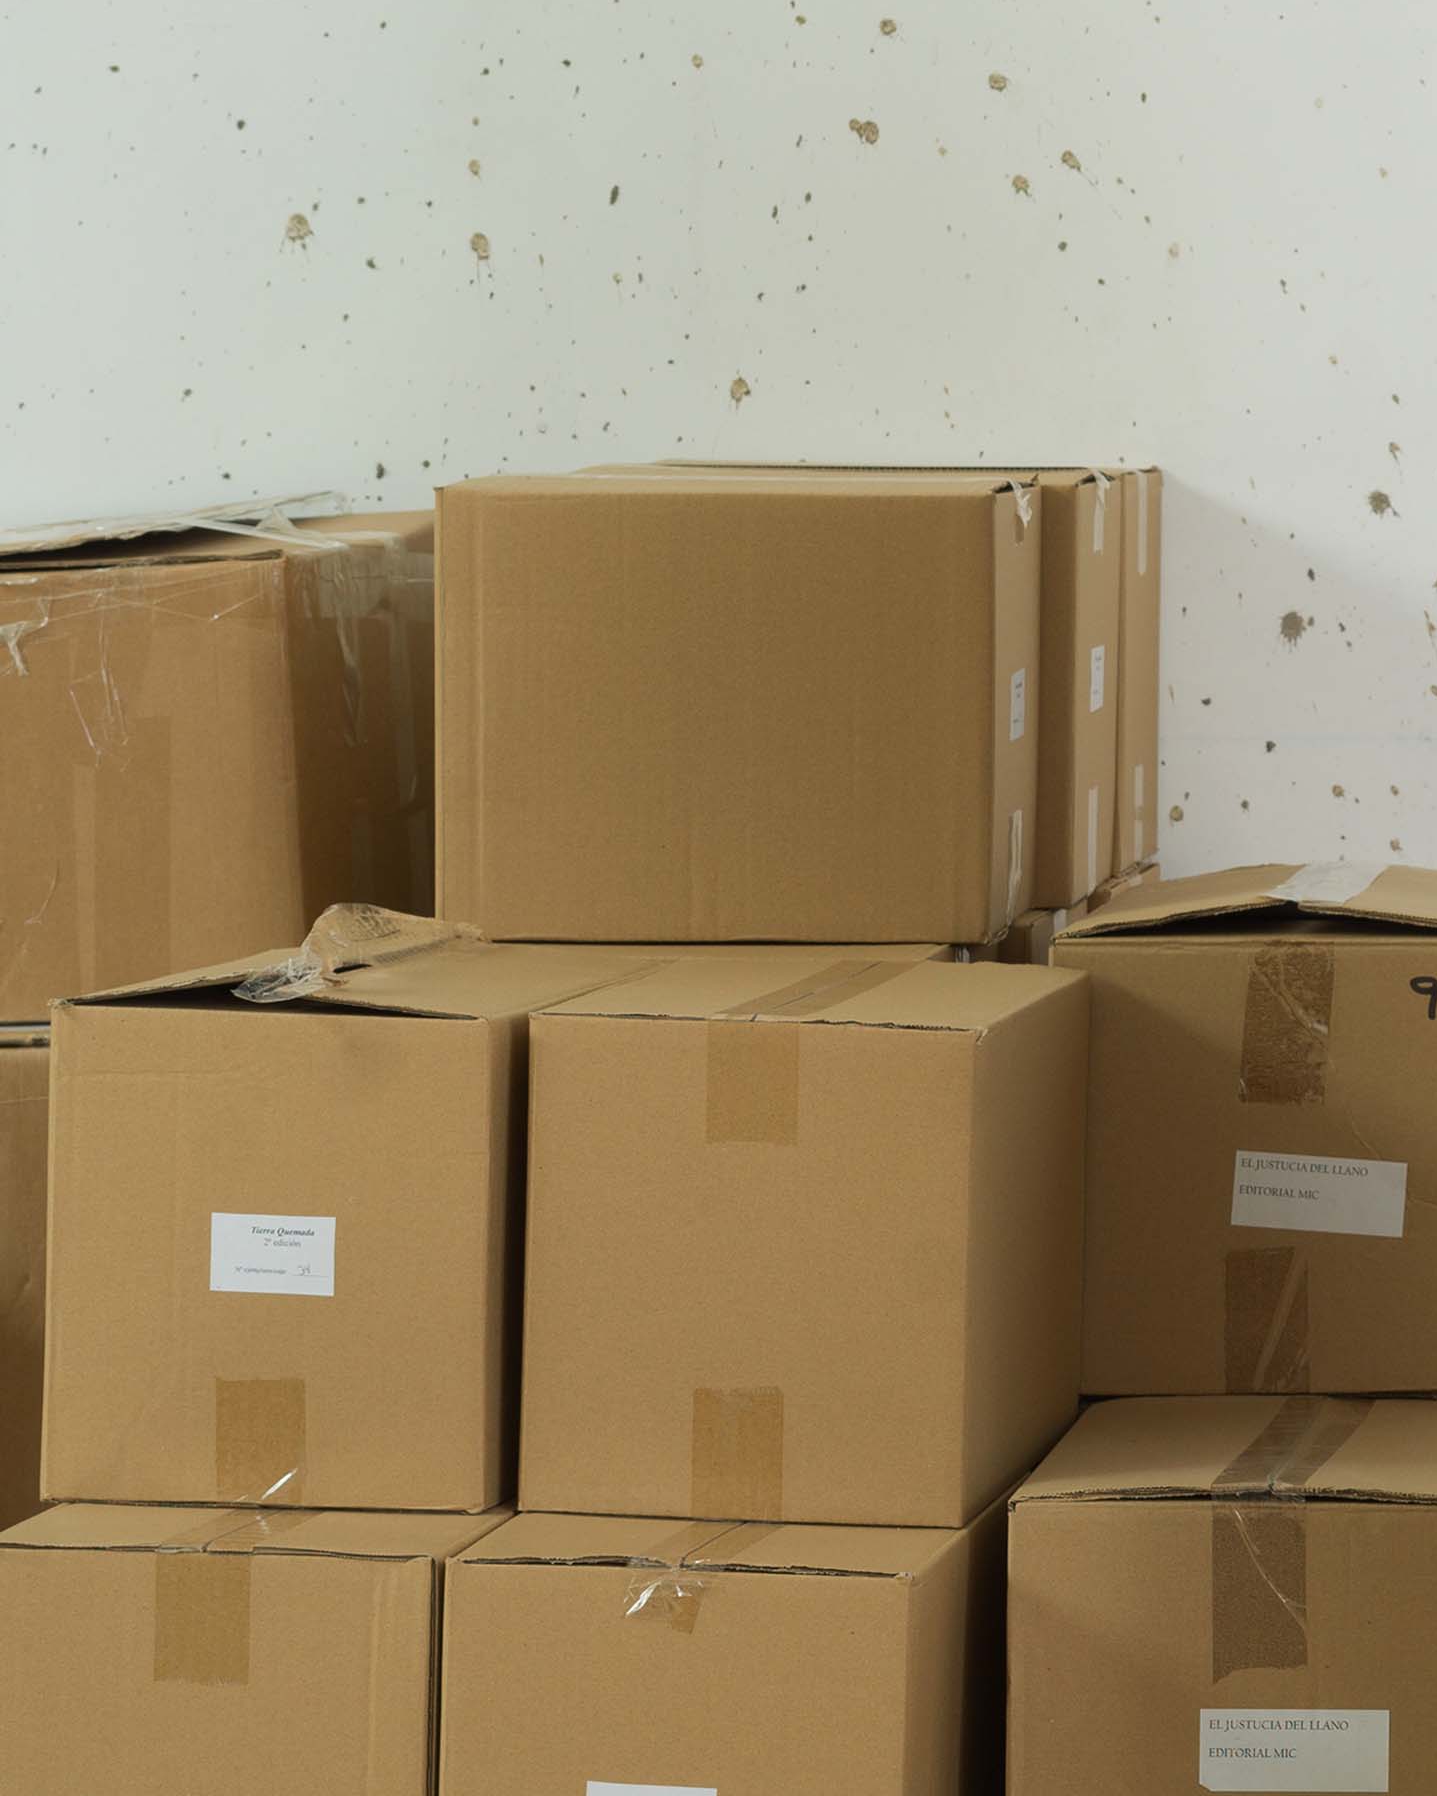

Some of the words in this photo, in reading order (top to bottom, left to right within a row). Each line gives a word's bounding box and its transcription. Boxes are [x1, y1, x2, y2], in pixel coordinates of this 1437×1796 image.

[1240, 1157, 1254, 1168] EL
[1254, 1159, 1308, 1172] JUSTUCIA
[1309, 1163, 1330, 1174] DEL
[1332, 1165, 1369, 1177] LLANO
[1239, 1185, 1296, 1198] EDITORIAL
[1298, 1189, 1320, 1201] MIC
[251, 1226, 276, 1235] Tierra
[276, 1227, 315, 1237] Quemada
[1209, 1719, 1224, 1730] EL
[1224, 1719, 1282, 1732] JUSTUCIA
[1285, 1720, 1308, 1731] DEL
[1310, 1720, 1349, 1731] LLANO
[1208, 1748, 1271, 1759] EDITORIAL
[1273, 1748, 1297, 1759] MIC
